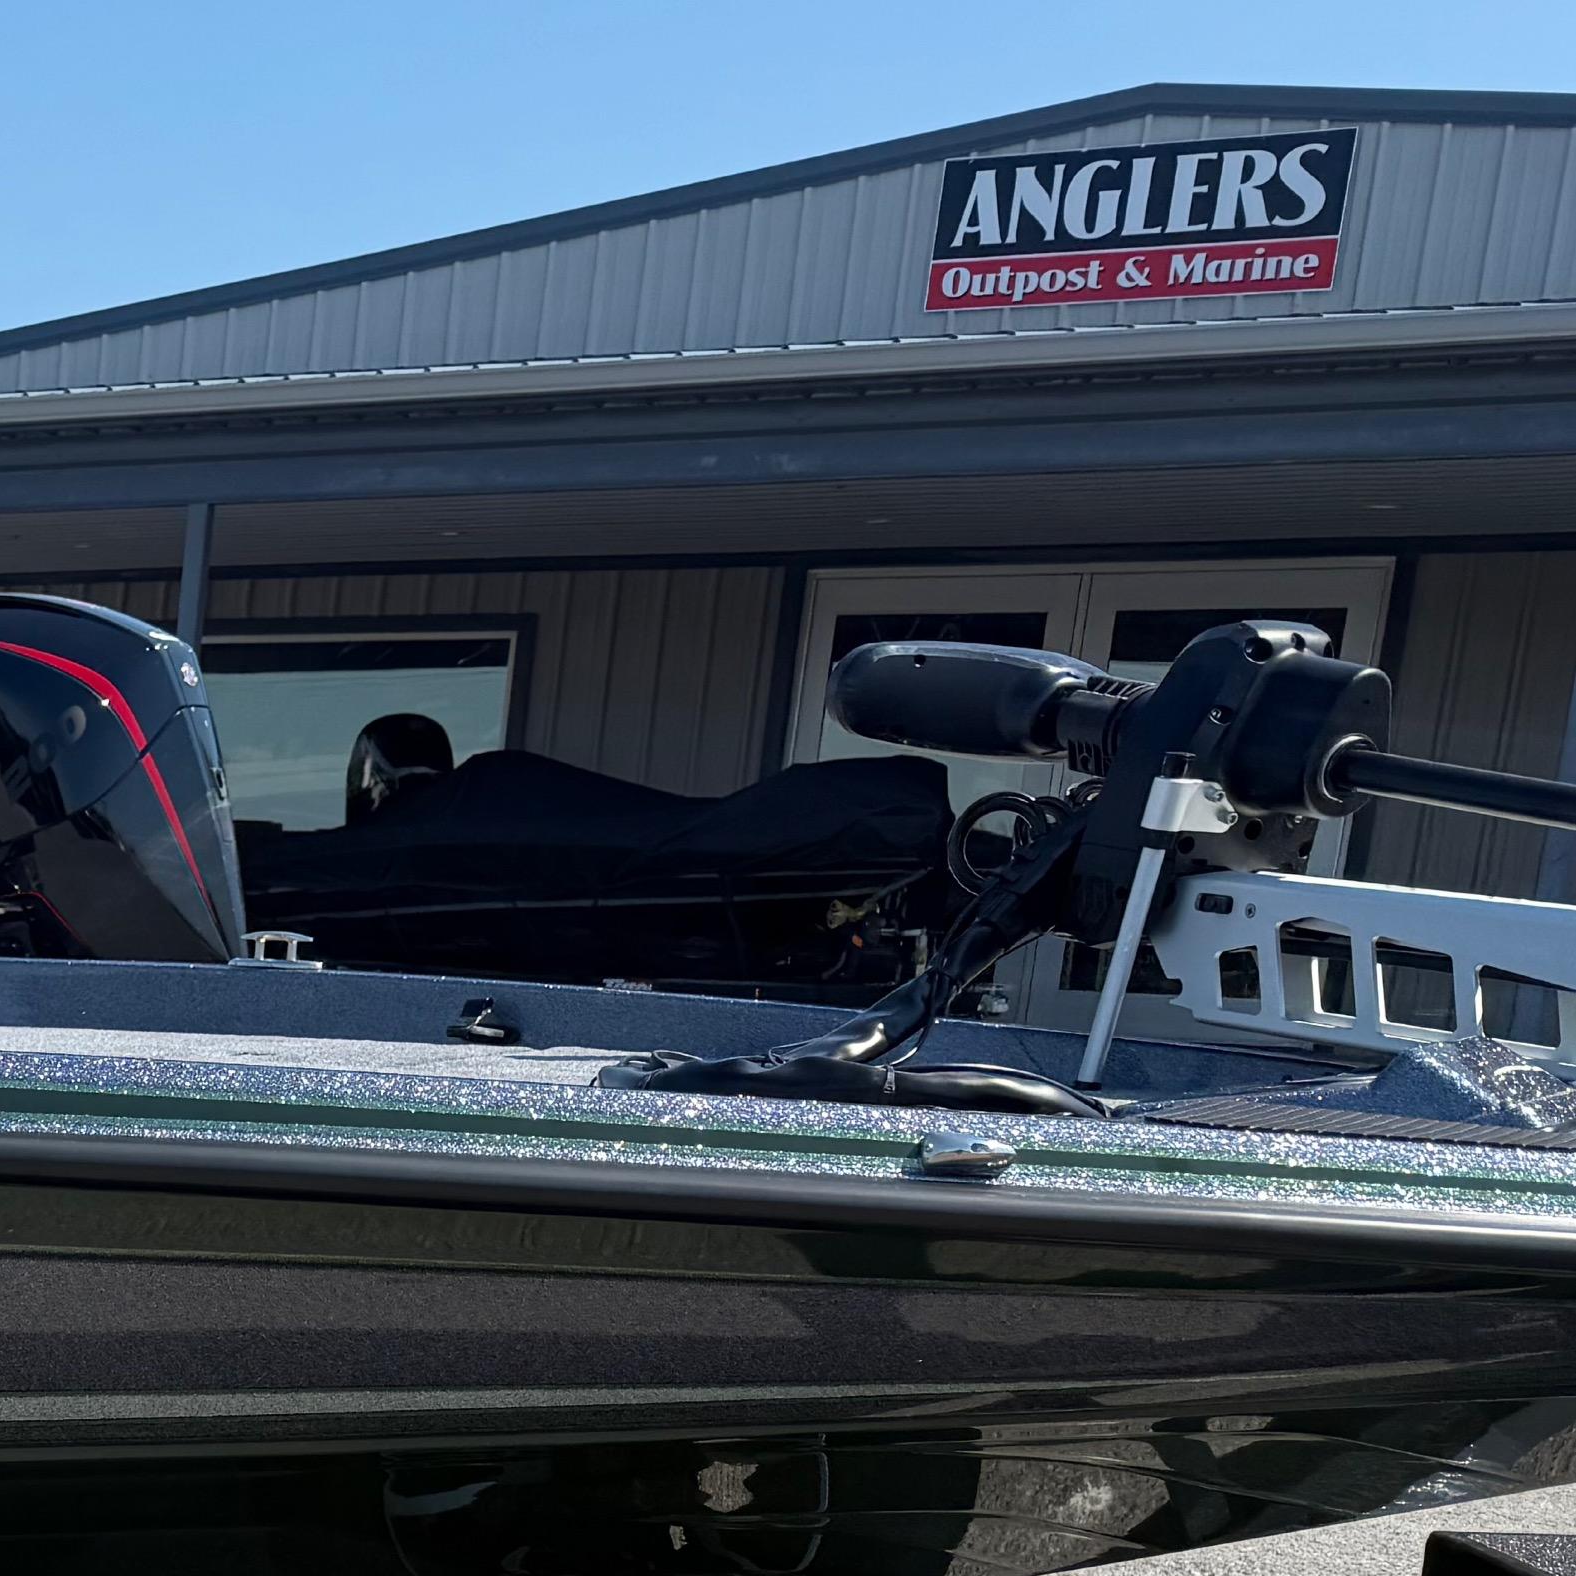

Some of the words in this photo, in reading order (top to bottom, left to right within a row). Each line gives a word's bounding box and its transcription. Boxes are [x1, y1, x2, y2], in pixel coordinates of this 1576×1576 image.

[950, 143, 1330, 248] ANGLERS
[942, 260, 1105, 302] Outpost
[1116, 256, 1151, 288] &
[1168, 247, 1320, 286] Marine
